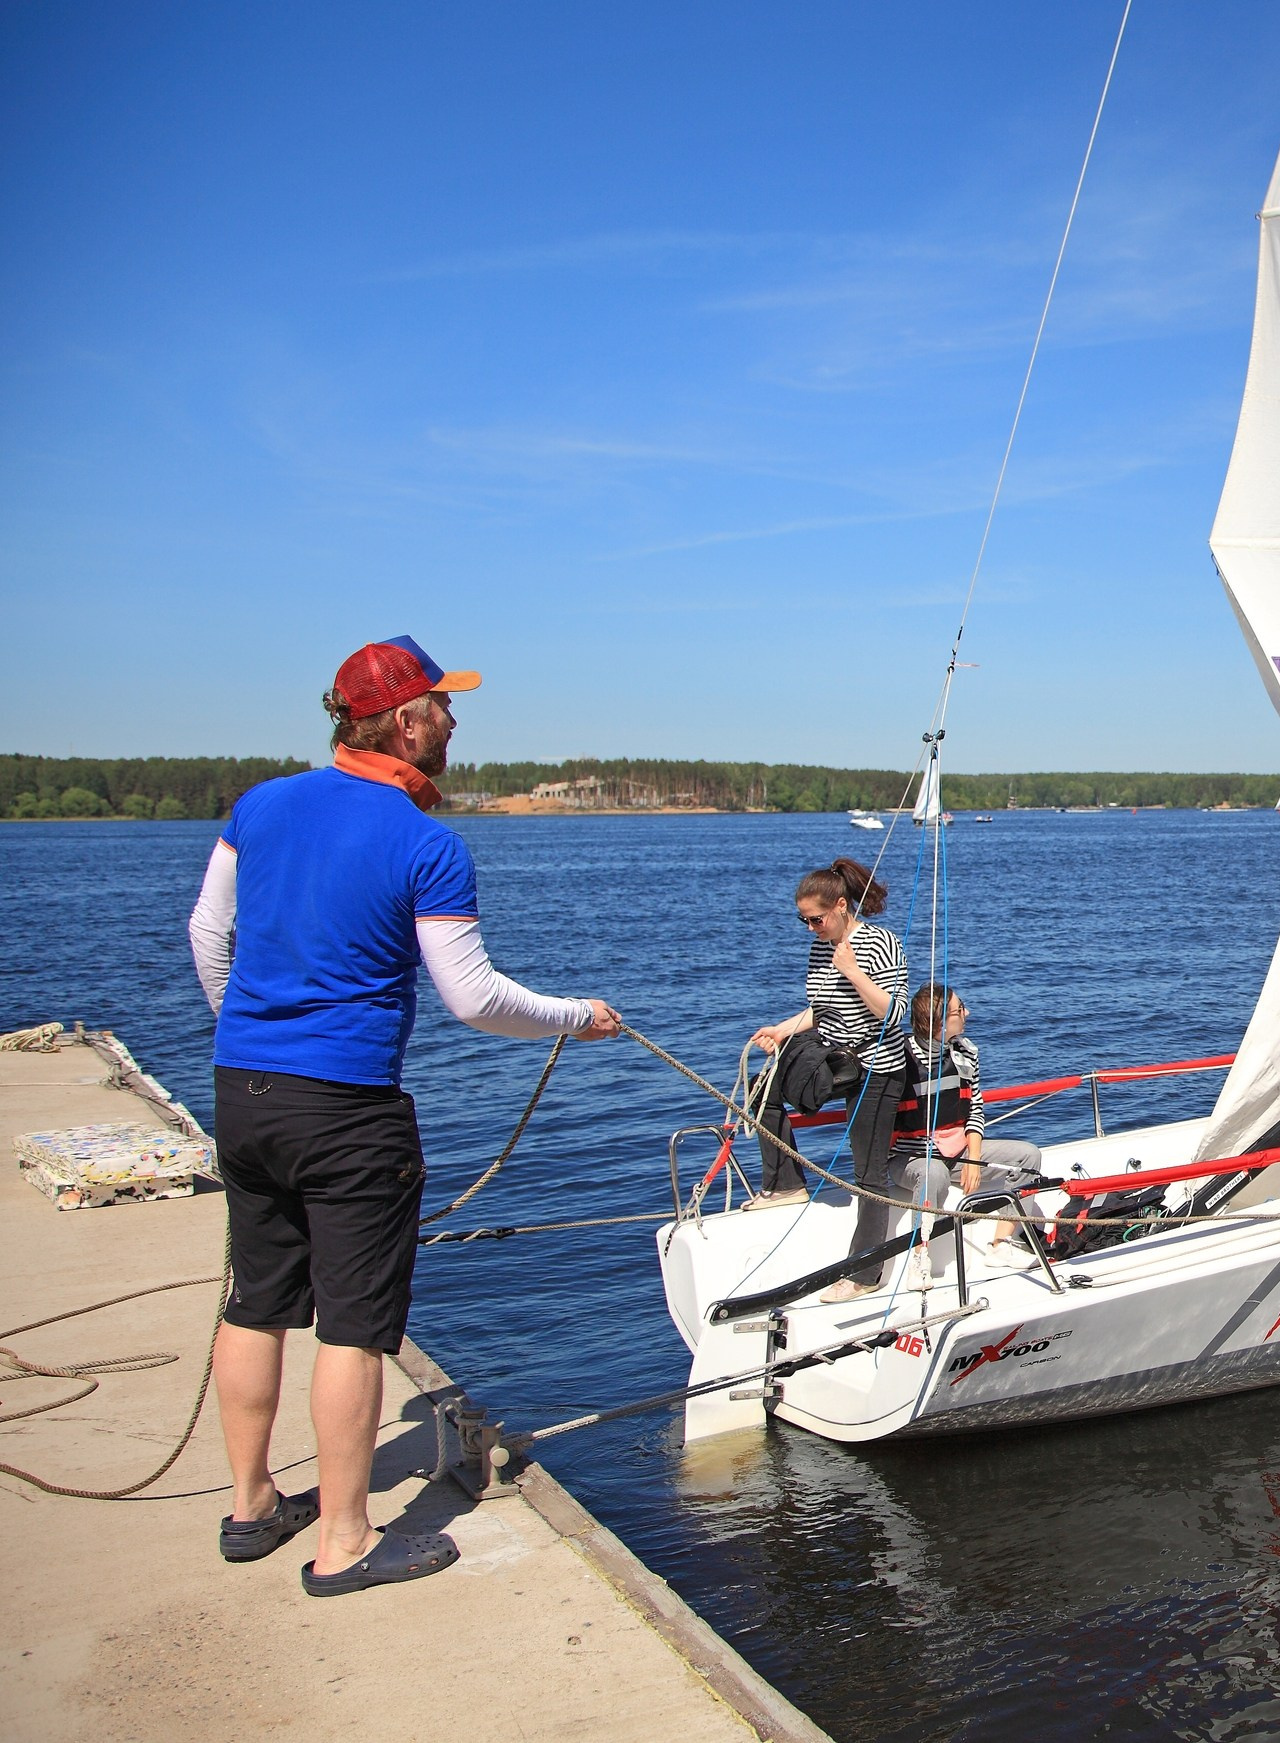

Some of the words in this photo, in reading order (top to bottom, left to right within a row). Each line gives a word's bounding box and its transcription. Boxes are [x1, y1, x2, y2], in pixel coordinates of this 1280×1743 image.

[1208, 1194, 1221, 1206] WIND
[1220, 1174, 1243, 1196] BROTHERS
[892, 1332, 925, 1358] 06
[948, 1324, 1050, 1386] MX700
[1020, 1355, 1061, 1368] CARBON
